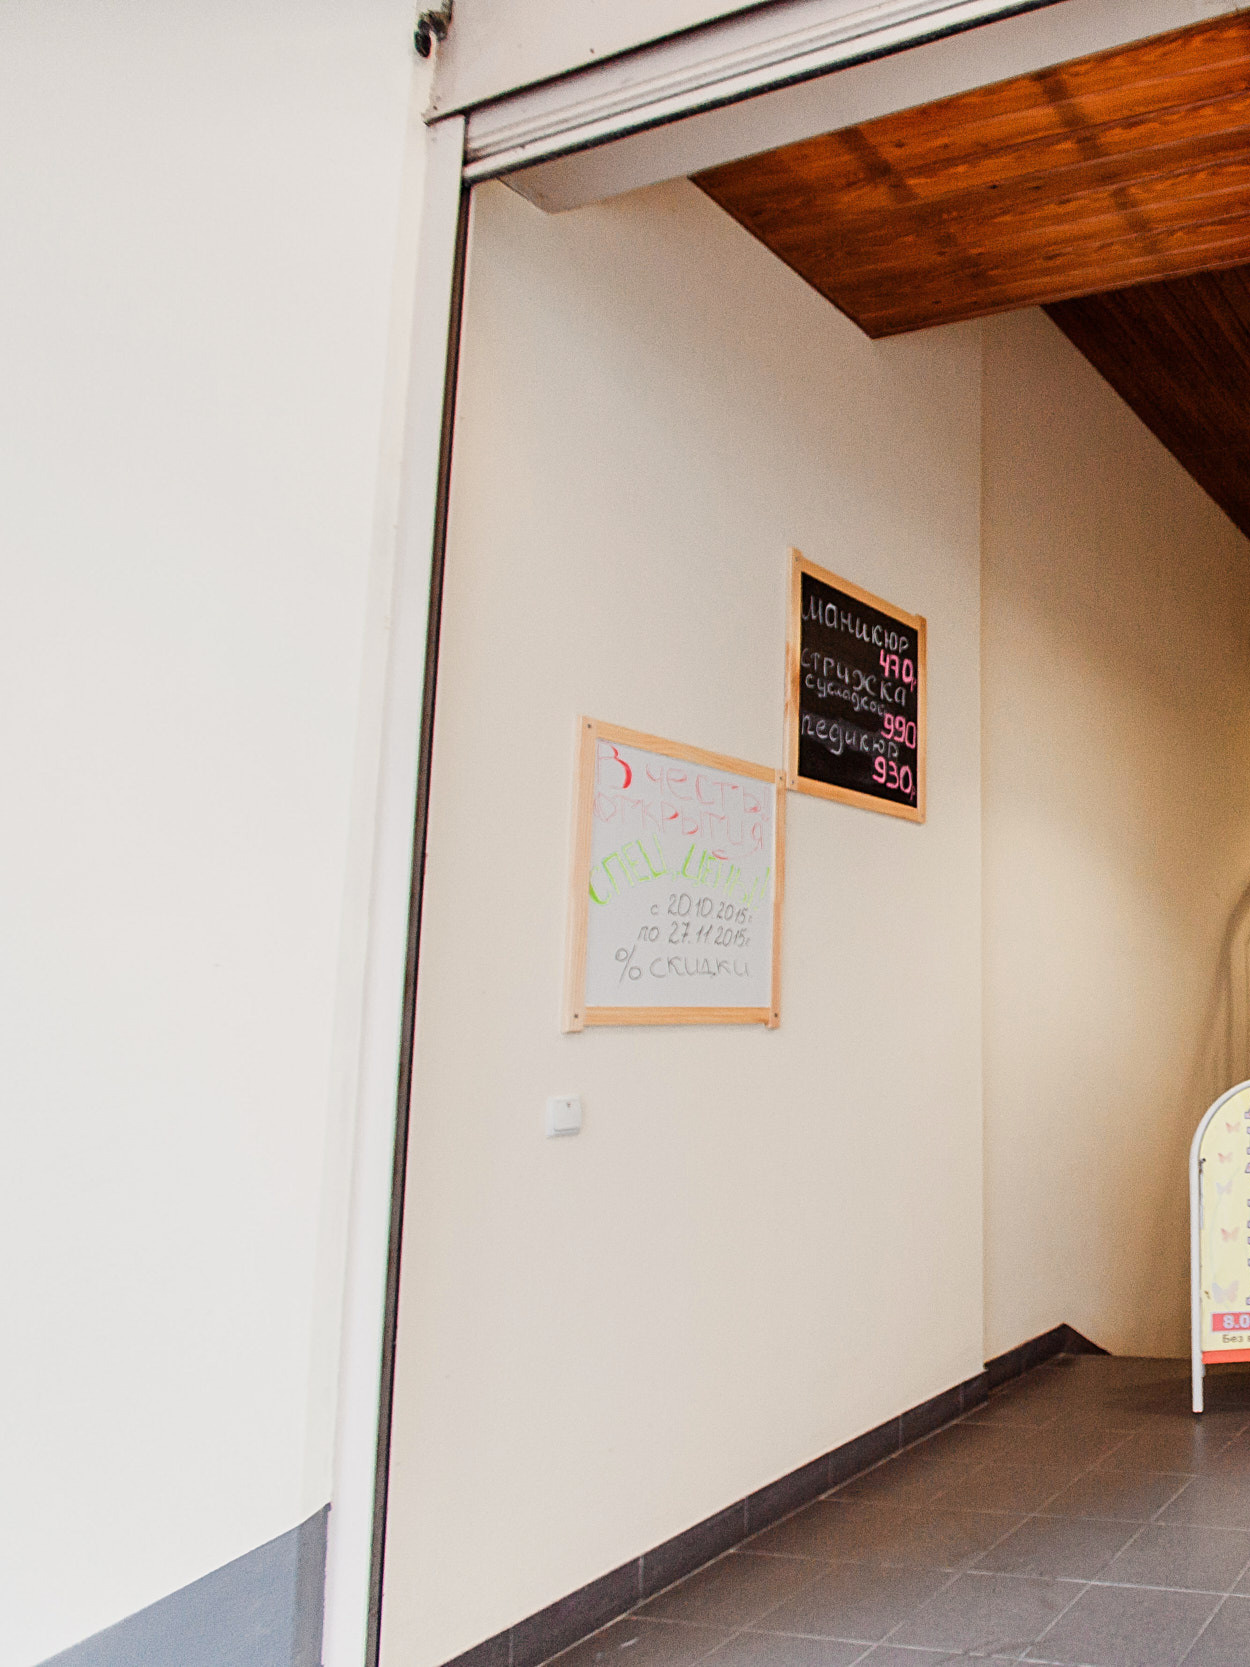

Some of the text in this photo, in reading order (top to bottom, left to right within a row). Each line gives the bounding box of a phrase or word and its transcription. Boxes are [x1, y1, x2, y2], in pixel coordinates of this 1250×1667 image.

[881, 713, 916, 750] 990
[597, 741, 632, 790] В
[1222, 1334, 1243, 1344] Без
